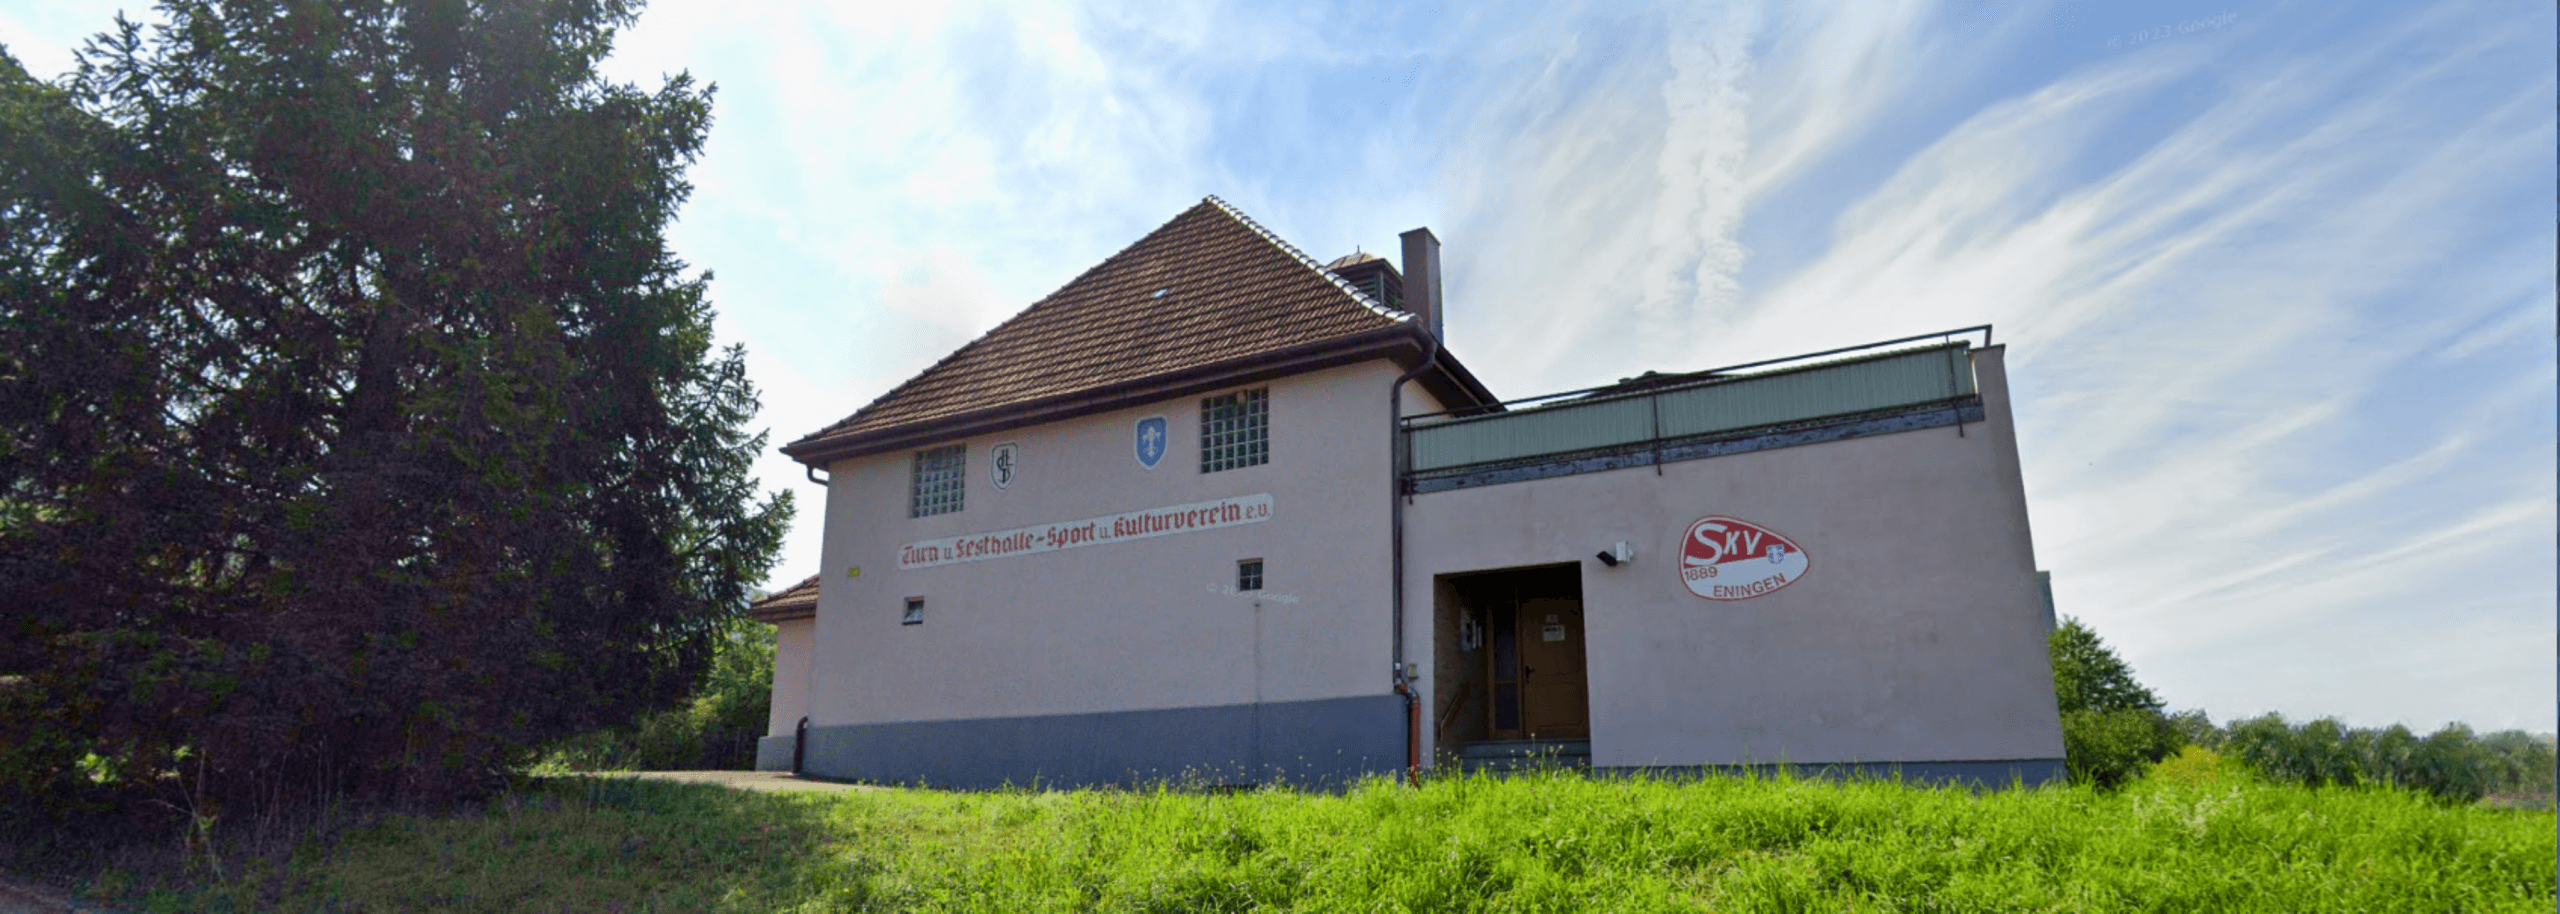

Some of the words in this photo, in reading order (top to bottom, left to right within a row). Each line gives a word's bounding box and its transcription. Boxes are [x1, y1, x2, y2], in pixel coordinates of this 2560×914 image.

[1114, 502, 1241, 538] Kulturverein
[1684, 566, 1718, 581] 1889
[1713, 573, 1786, 597] ENINGEN
